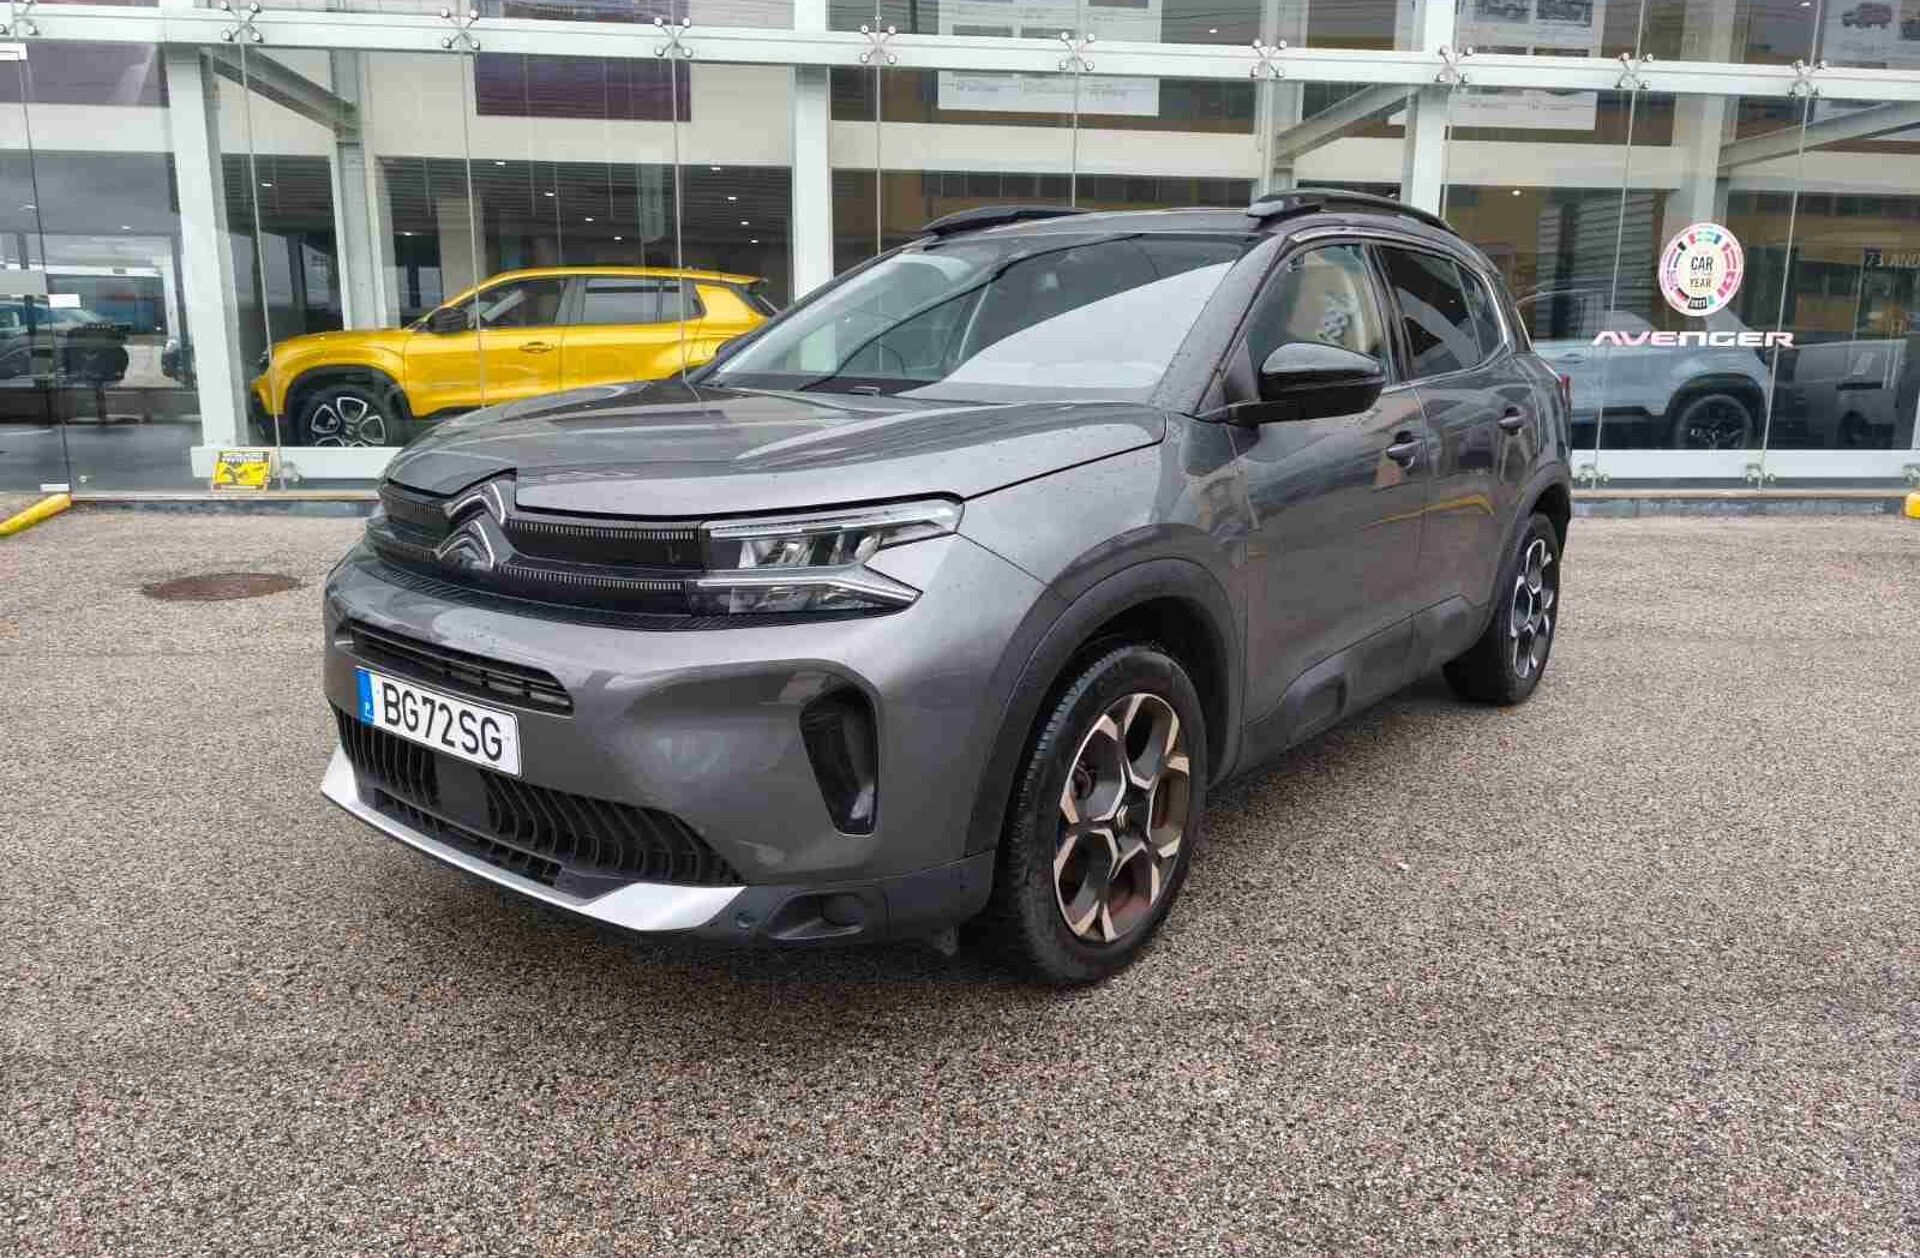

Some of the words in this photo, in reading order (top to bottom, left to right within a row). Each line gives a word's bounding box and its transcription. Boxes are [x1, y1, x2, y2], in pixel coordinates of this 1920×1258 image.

[1691, 256, 1714, 271] CAR
[1689, 278, 1712, 288] YEAR
[1591, 330, 1795, 348] AVENGER
[382, 681, 502, 762] BG72SG
